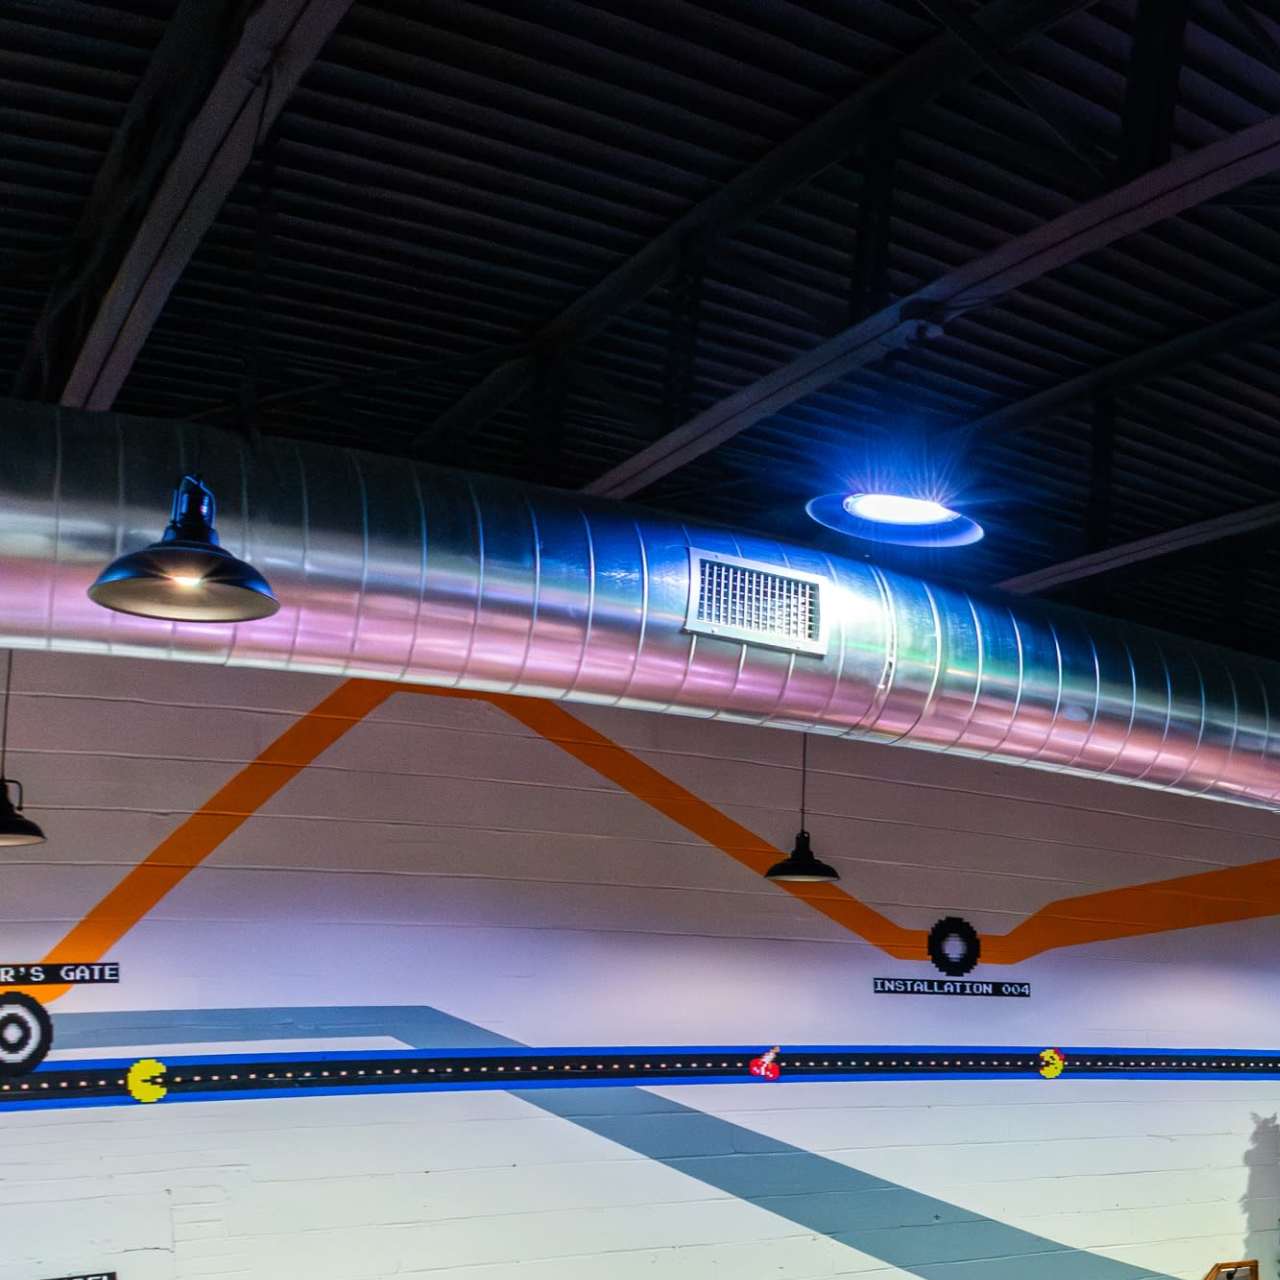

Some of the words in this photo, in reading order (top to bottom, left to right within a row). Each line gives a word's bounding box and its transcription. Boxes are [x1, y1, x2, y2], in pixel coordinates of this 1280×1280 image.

[61, 966, 119, 981] GATE
[874, 979, 993, 996] INSTALLATION
[1002, 982, 1030, 996] 004
